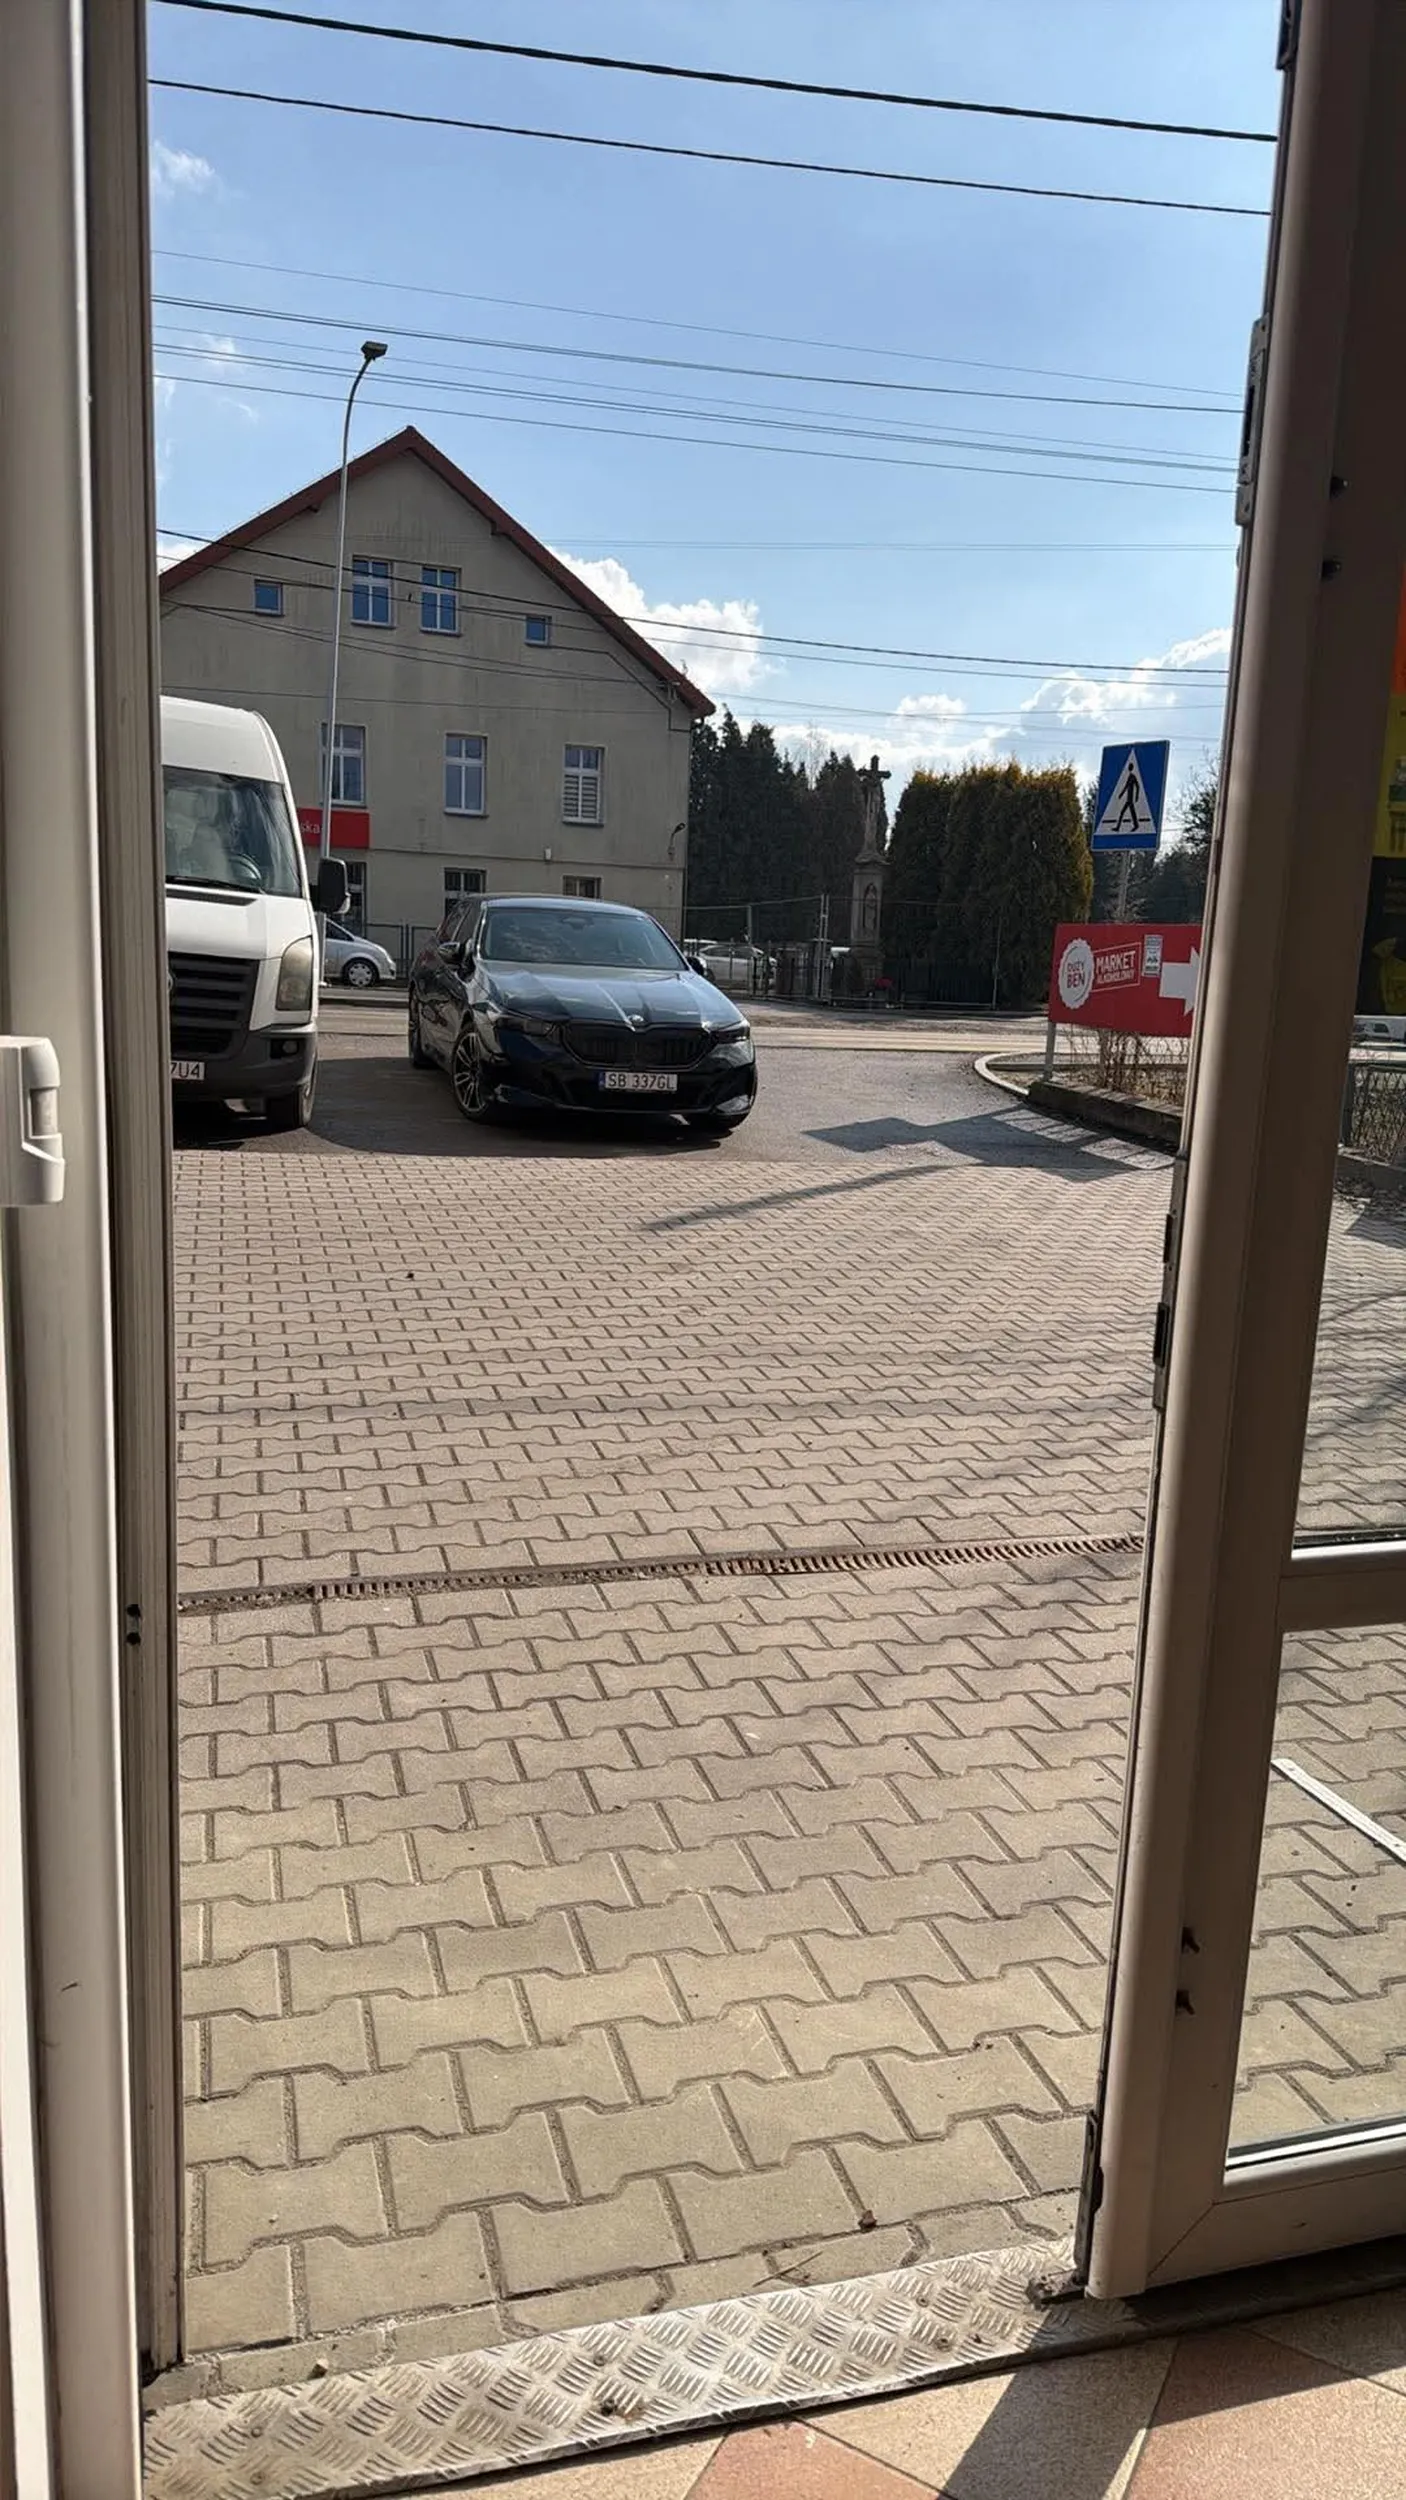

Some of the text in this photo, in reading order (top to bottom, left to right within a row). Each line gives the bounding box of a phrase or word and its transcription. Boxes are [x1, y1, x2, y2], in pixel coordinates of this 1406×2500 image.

[1096, 950, 1136, 974] MARKET
[1067, 972, 1086, 988] BEN
[608, 1073, 675, 1090] SB 337GL
